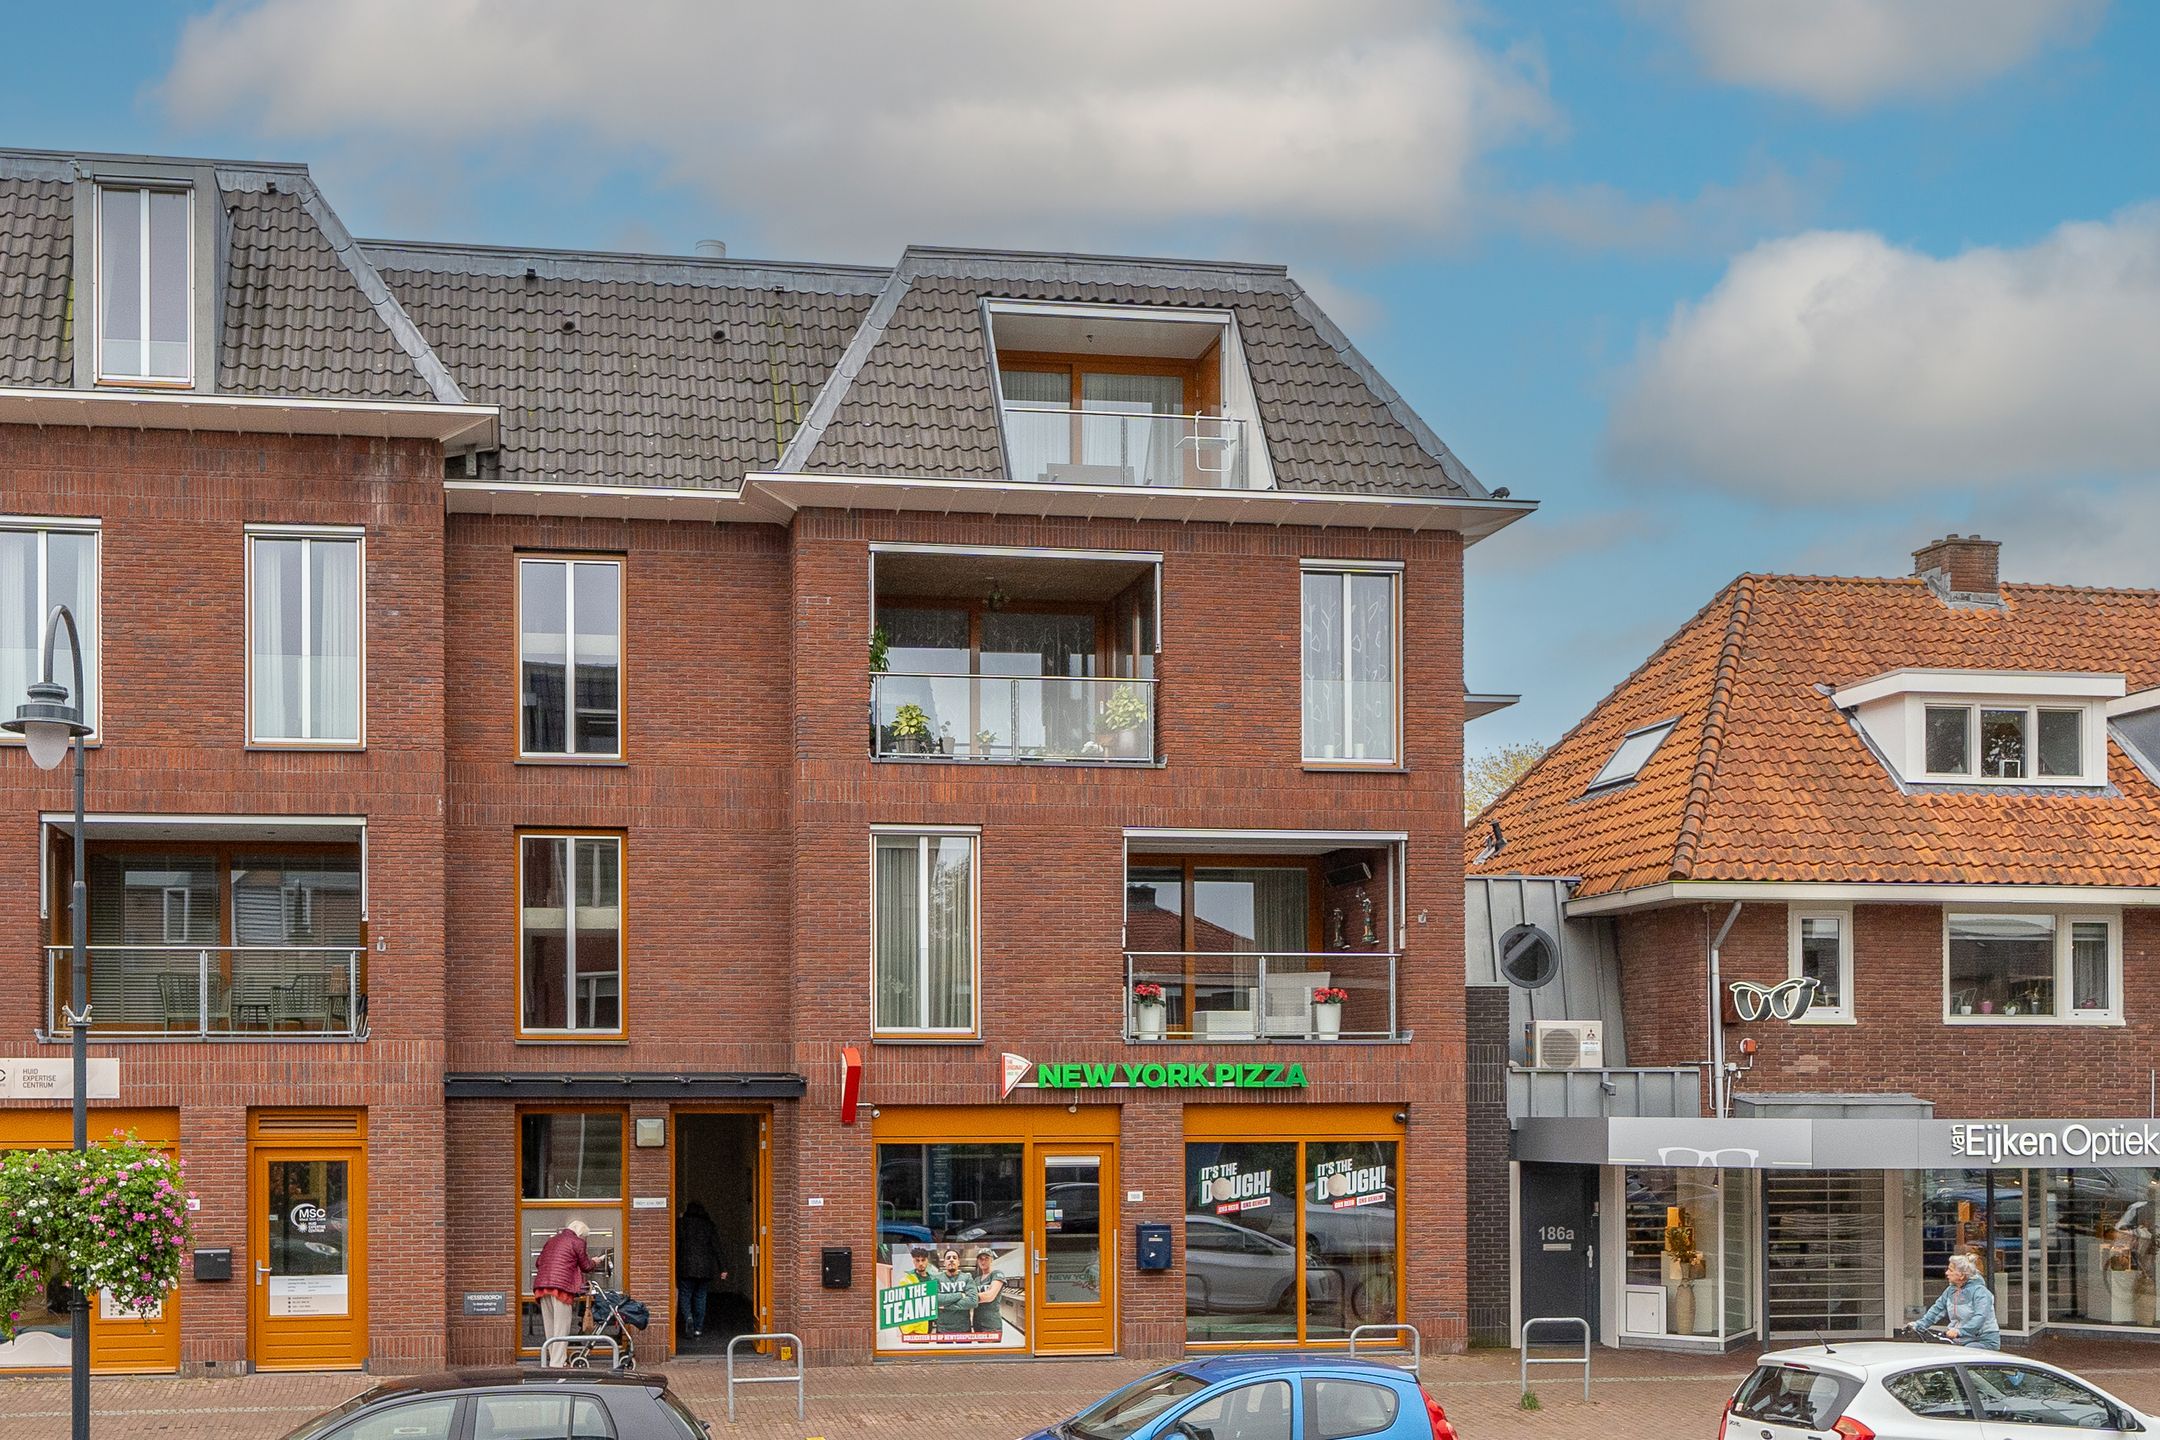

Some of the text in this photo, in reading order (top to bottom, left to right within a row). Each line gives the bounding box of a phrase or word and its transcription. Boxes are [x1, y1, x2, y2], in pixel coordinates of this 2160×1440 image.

[1038, 1063, 1308, 1088] NEW YORK PIZZA
[1952, 1124, 2160, 1163] van Eijken Optiek
[1201, 1162, 1238, 1181] IT'S THE
[1317, 1158, 1353, 1177] IT'S THE
[299, 1208, 326, 1218] MSC
[1538, 1226, 1575, 1240] 186a
[883, 1283, 927, 1304] JOIN THE
[940, 1281, 966, 1293] NYP
[883, 1295, 936, 1325] TEAM!
